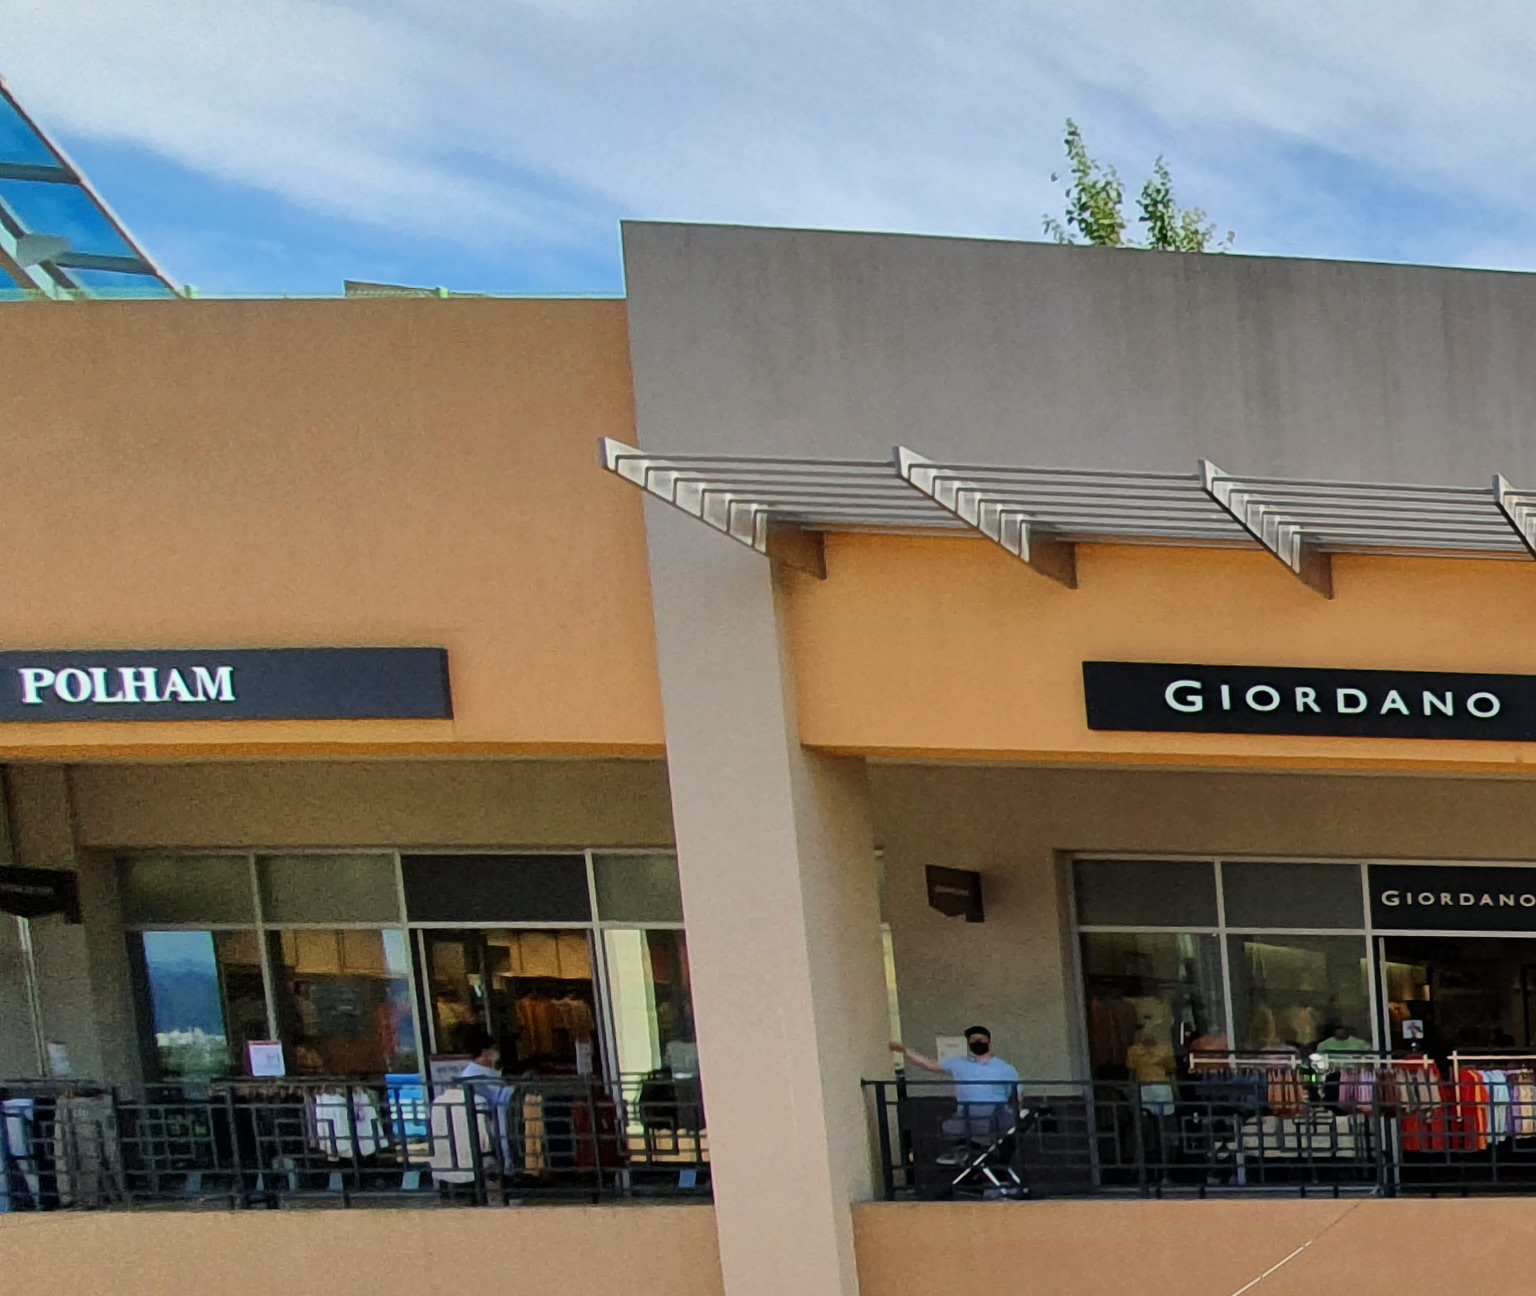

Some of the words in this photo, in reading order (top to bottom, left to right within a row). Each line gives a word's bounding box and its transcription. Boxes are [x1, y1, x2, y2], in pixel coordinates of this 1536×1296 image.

[18, 667, 236, 704] POLHAM
[1164, 680, 1501, 718] GIORDANO
[1381, 890, 1536, 907] GIORDANO
